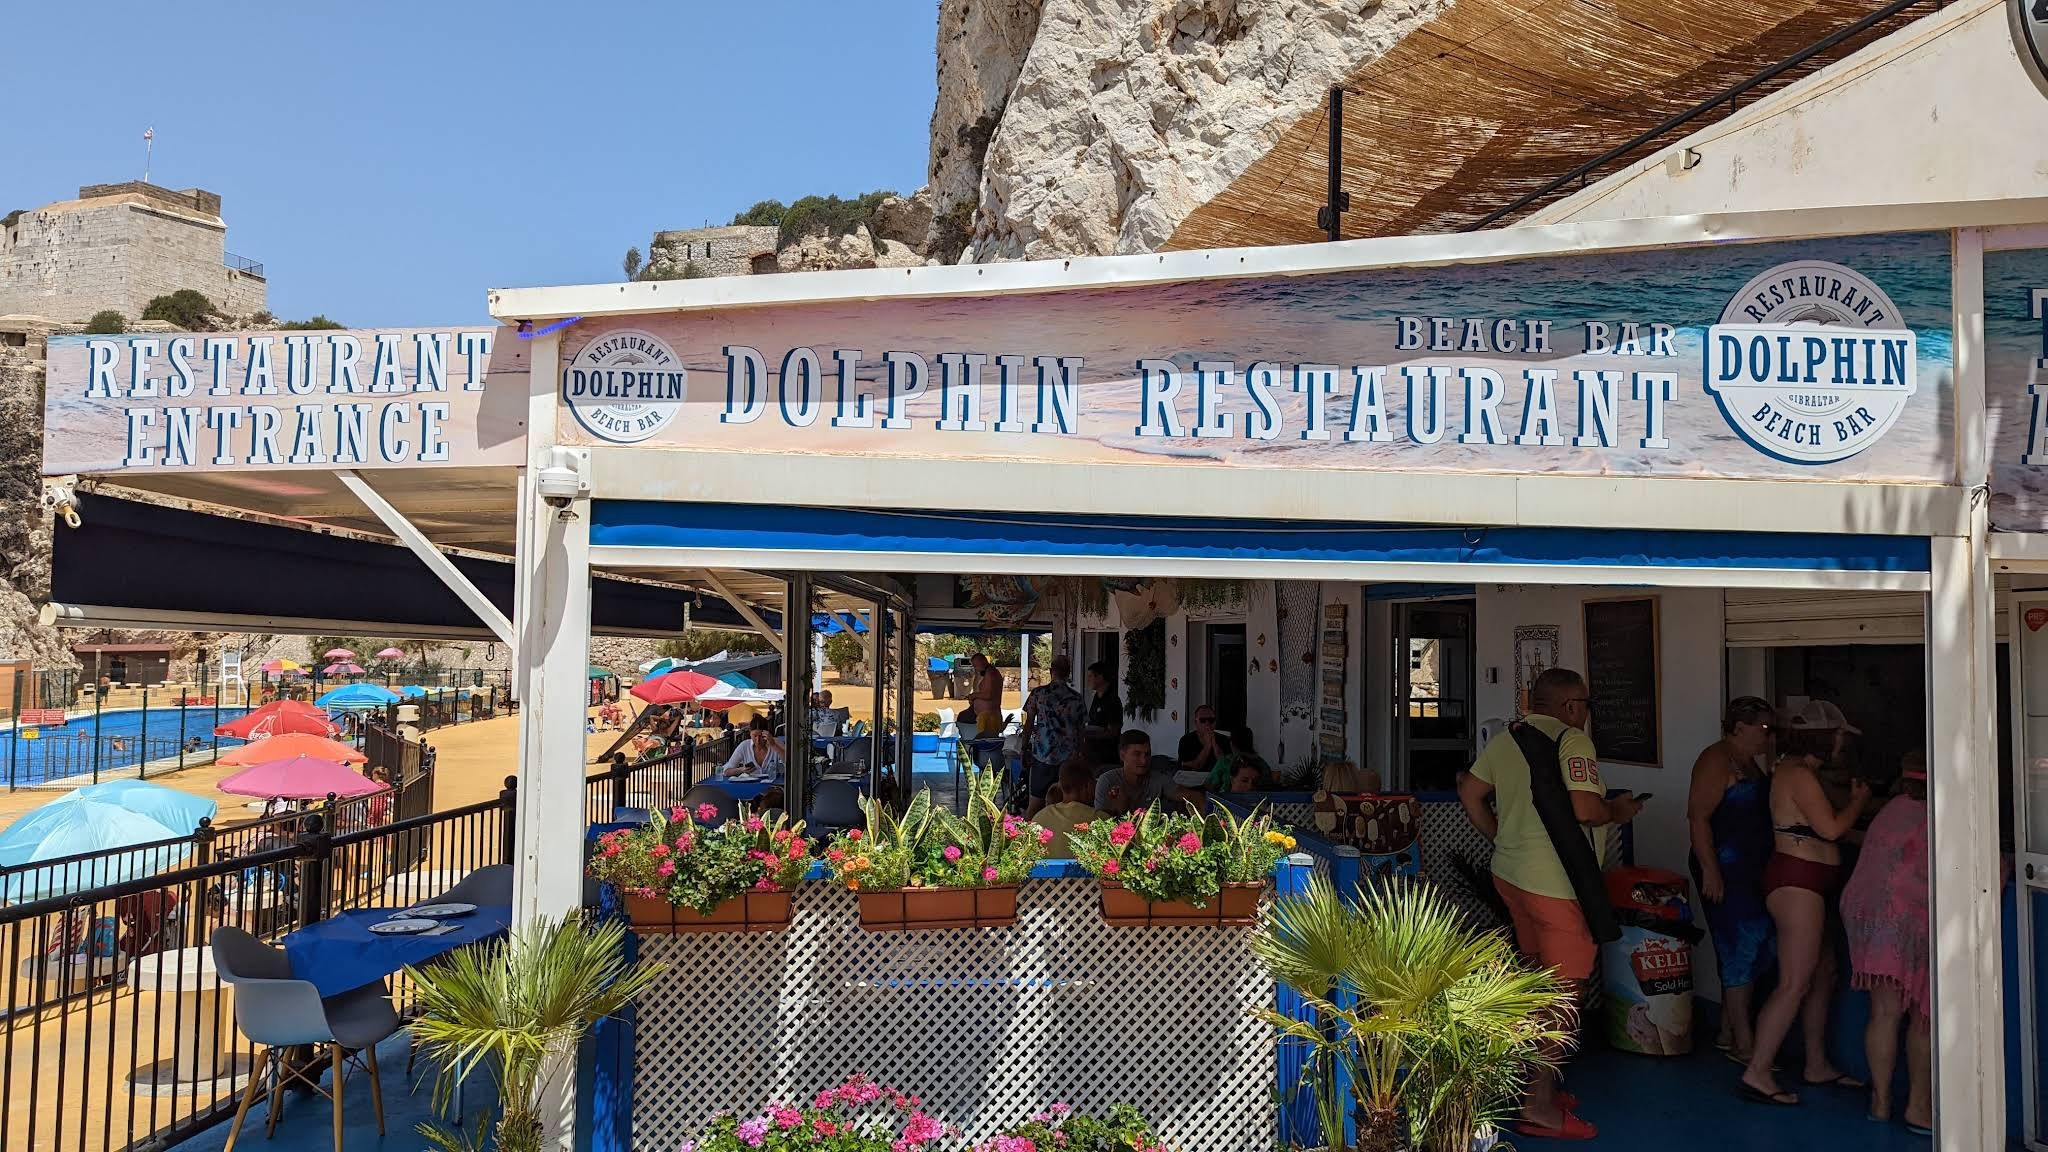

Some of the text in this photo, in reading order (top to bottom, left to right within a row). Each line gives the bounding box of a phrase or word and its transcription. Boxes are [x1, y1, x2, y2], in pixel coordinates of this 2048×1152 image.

[1744, 275, 1885, 327] RESTAURANT
[588, 337, 670, 366] RESTAURANT
[1395, 316, 1679, 357] BEACH BAR
[84, 332, 492, 398] RESTAURANT
[1718, 334, 1908, 386] DOLPHIN
[572, 370, 683, 399] DOLPHIN
[720, 345, 1679, 449] DOLPHIN RESTAURANT
[1788, 394, 1841, 407] GIBRALTAR
[123, 402, 450, 466] ENTRANCE
[590, 408, 663, 433] BEACH BAR
[1752, 402, 1876, 446] BEACH BAR
[1568, 757, 1599, 785] 85
[1654, 979, 1676, 992] Sold
